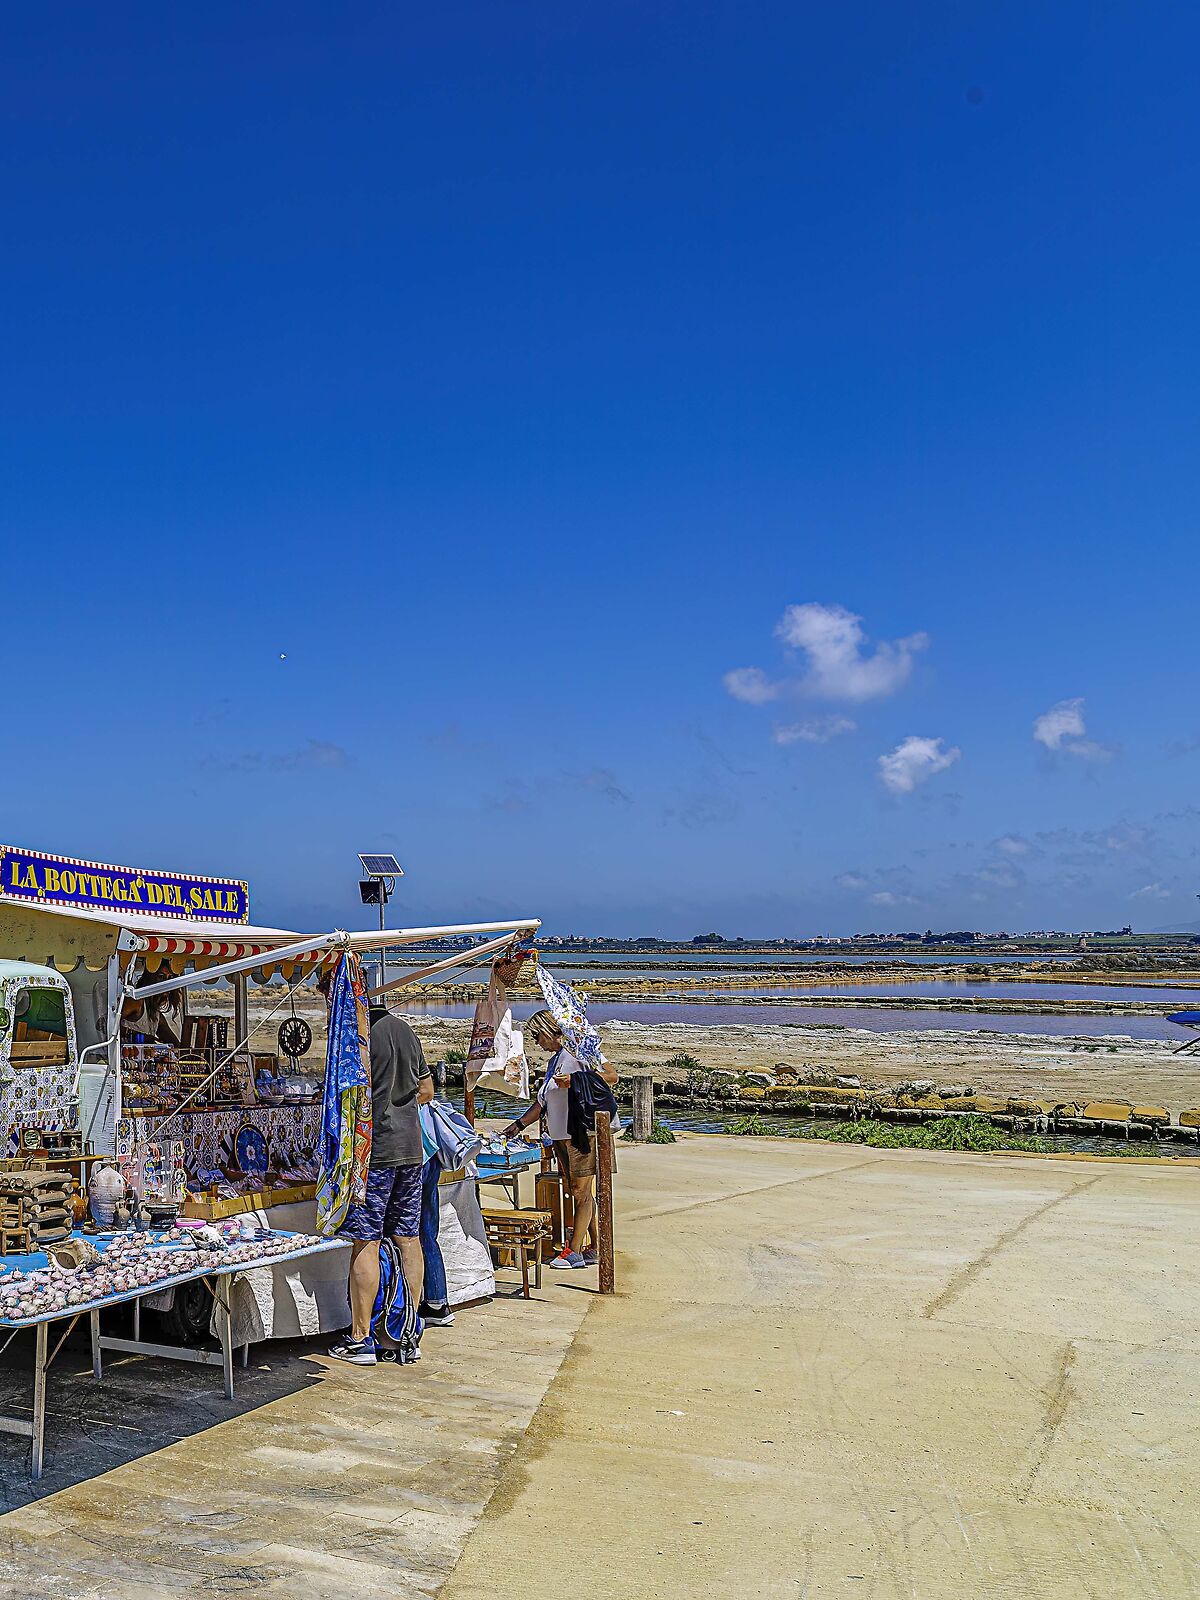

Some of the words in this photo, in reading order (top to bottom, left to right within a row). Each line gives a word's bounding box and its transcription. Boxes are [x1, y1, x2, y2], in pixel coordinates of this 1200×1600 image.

[10, 861, 38, 889] LA
[43, 867, 143, 903] BOTTEGA
[145, 882, 187, 908] DEL
[190, 886, 239, 913] SALE
